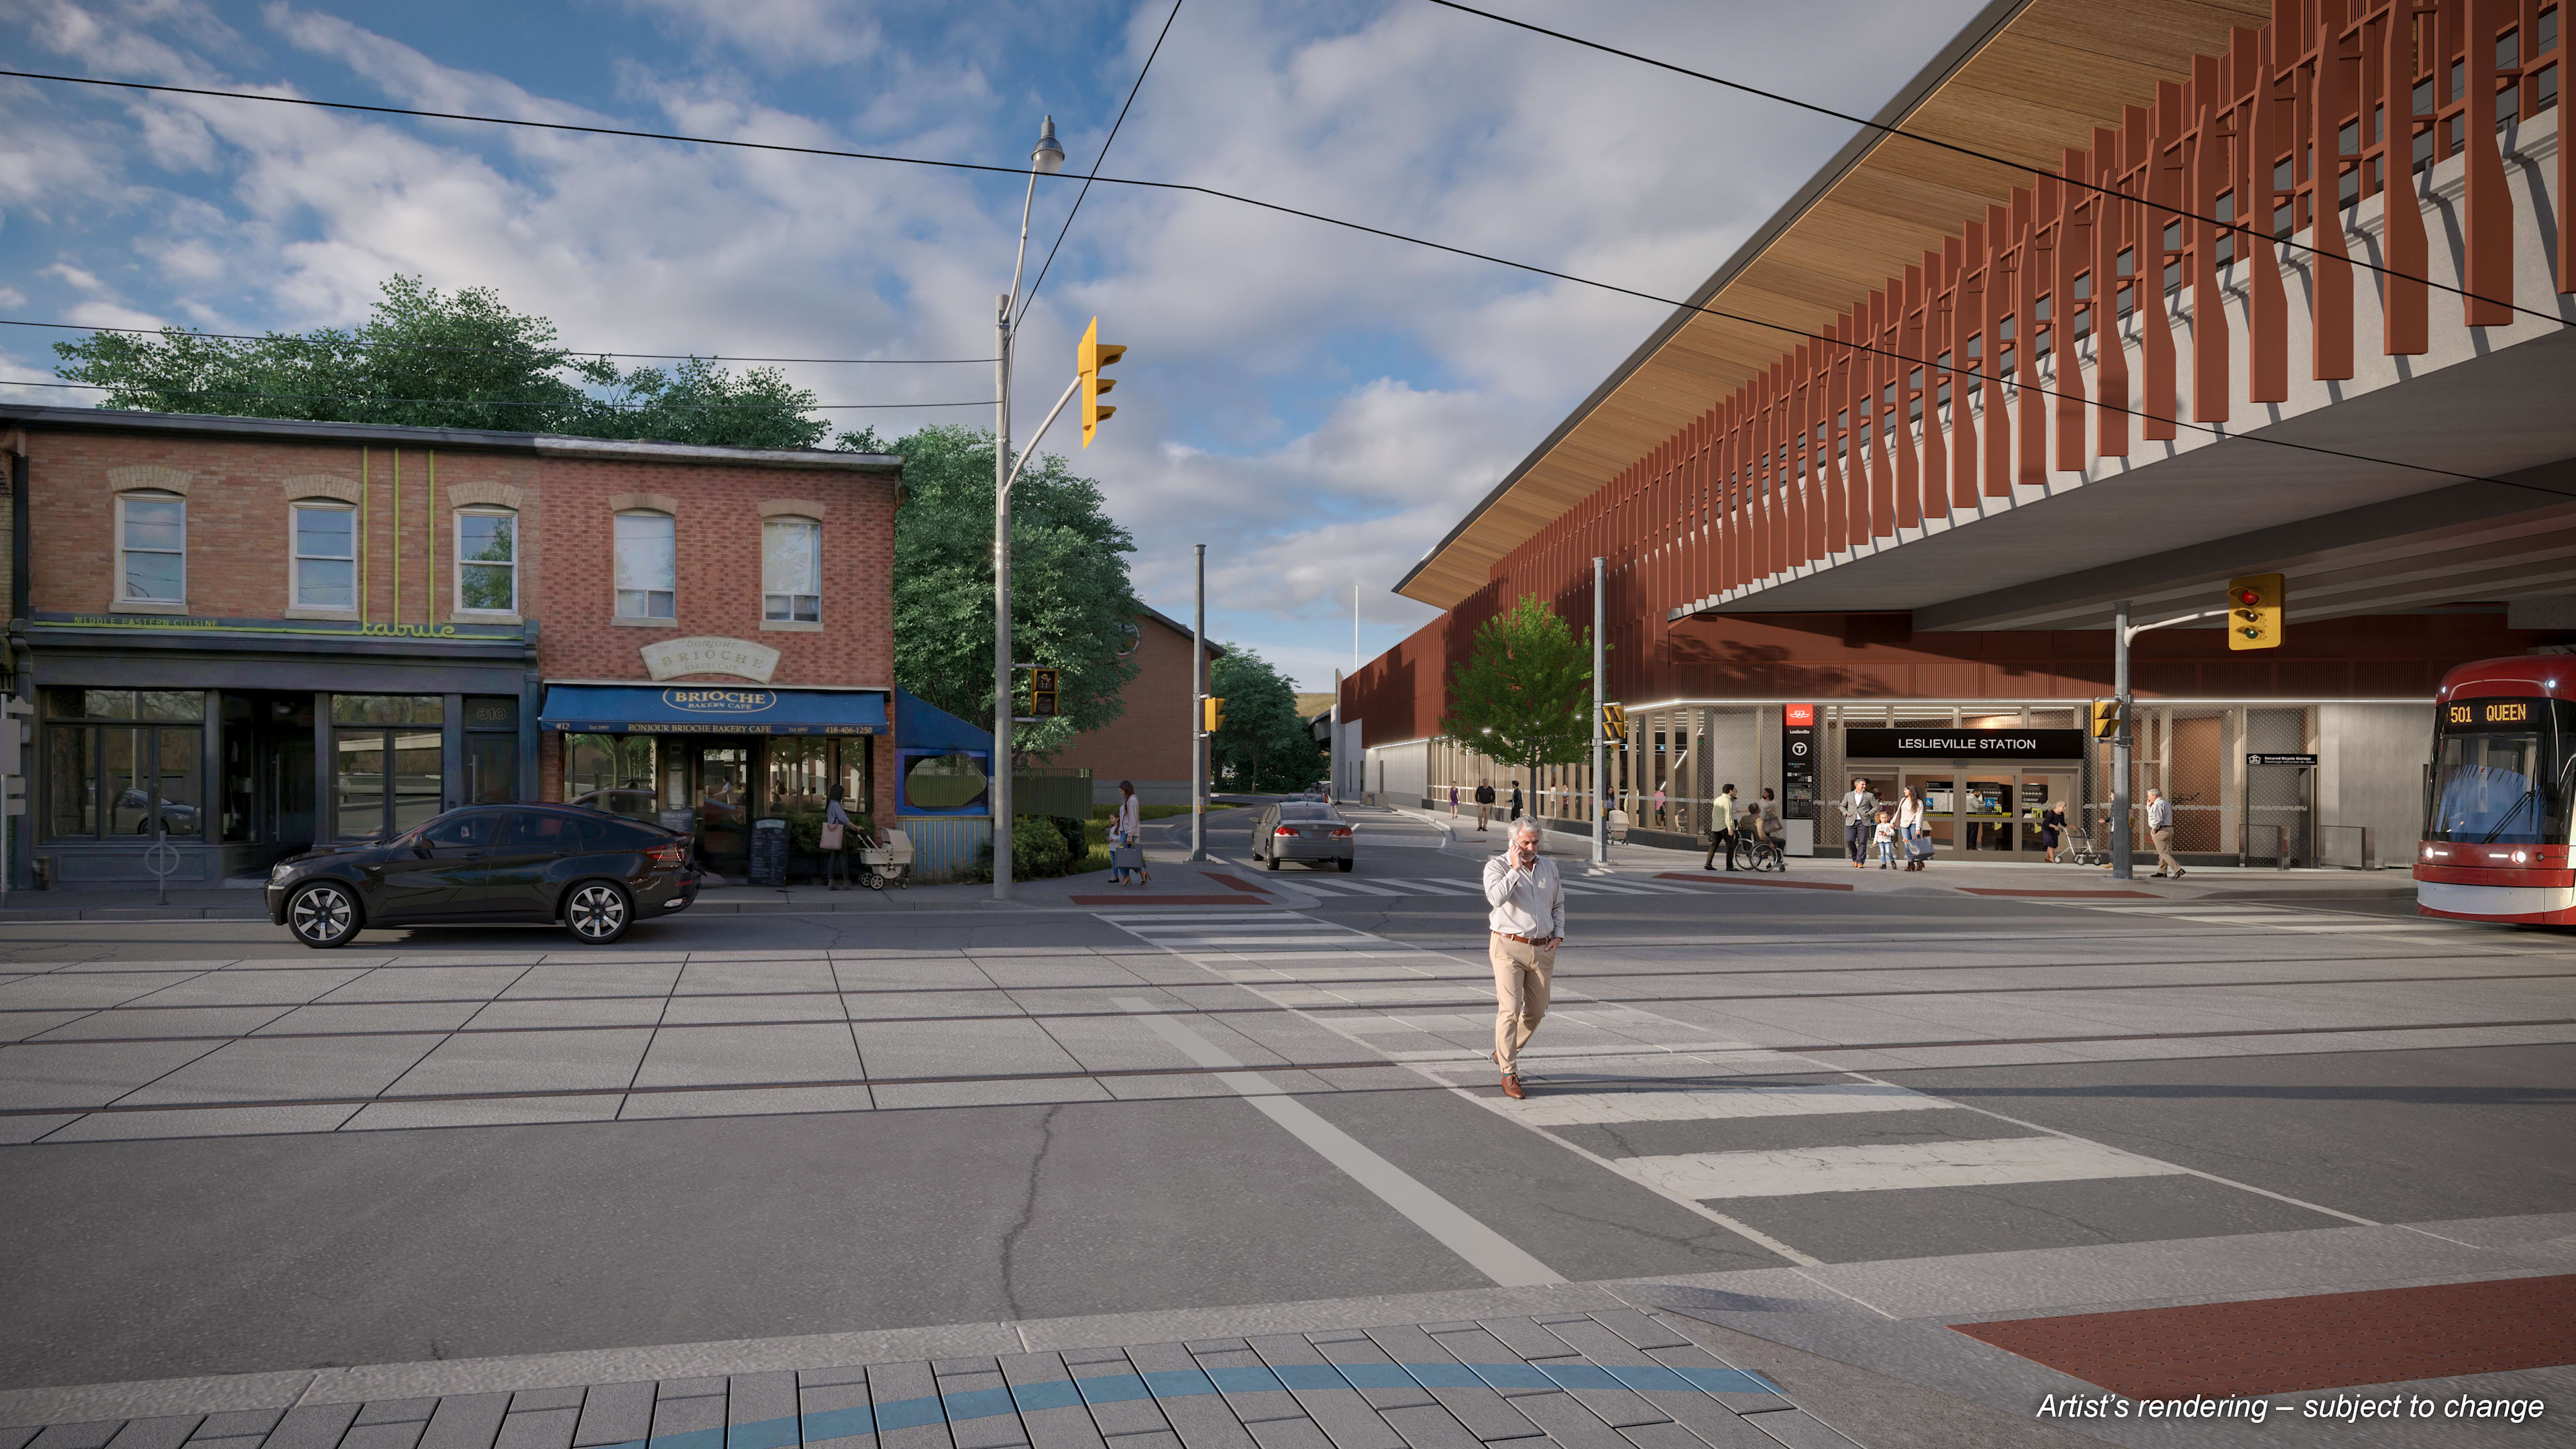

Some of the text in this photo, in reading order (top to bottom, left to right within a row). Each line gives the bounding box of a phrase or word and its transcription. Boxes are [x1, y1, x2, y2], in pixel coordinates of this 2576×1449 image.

[74, 616, 219, 627] MIDDLE EASTERN CUISINE
[661, 649, 764, 669] BRIOCHE
[684, 661, 715, 671] BAKERY
[674, 691, 766, 704] BRIOCHE
[476, 708, 507, 720] 310
[2451, 704, 2526, 723] 501 QUEEN
[672, 724, 710, 732] BRIOCHE
[1898, 739, 2036, 749] LESLIEVILLE STATION
